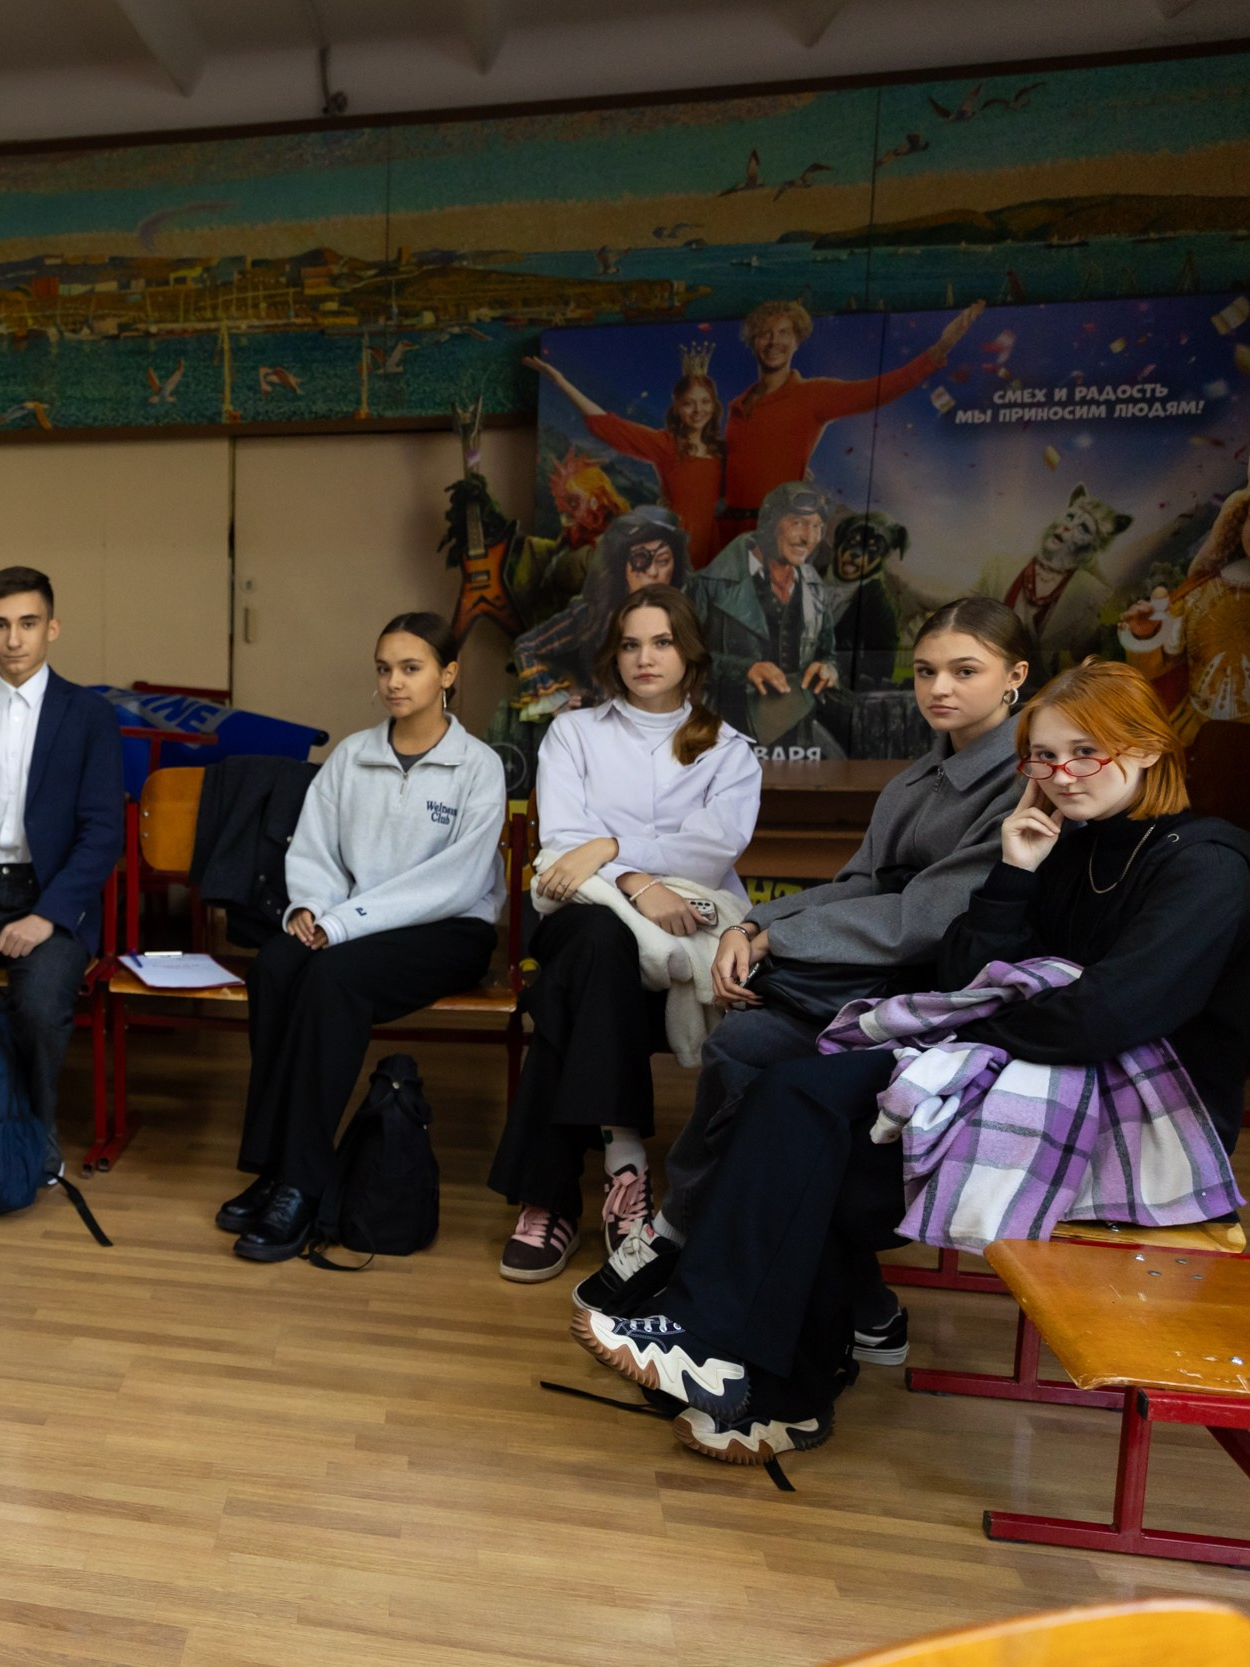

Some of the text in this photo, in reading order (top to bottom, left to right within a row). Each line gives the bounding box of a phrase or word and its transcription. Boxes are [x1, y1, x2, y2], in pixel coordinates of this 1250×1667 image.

[993, 383, 1168, 404] СМЕХ И РАДОСТЬ
[954, 400, 1205, 424] МЫ ПРИНОСИМ ЛЮДЯМ!
[431, 812, 450, 825] Club
